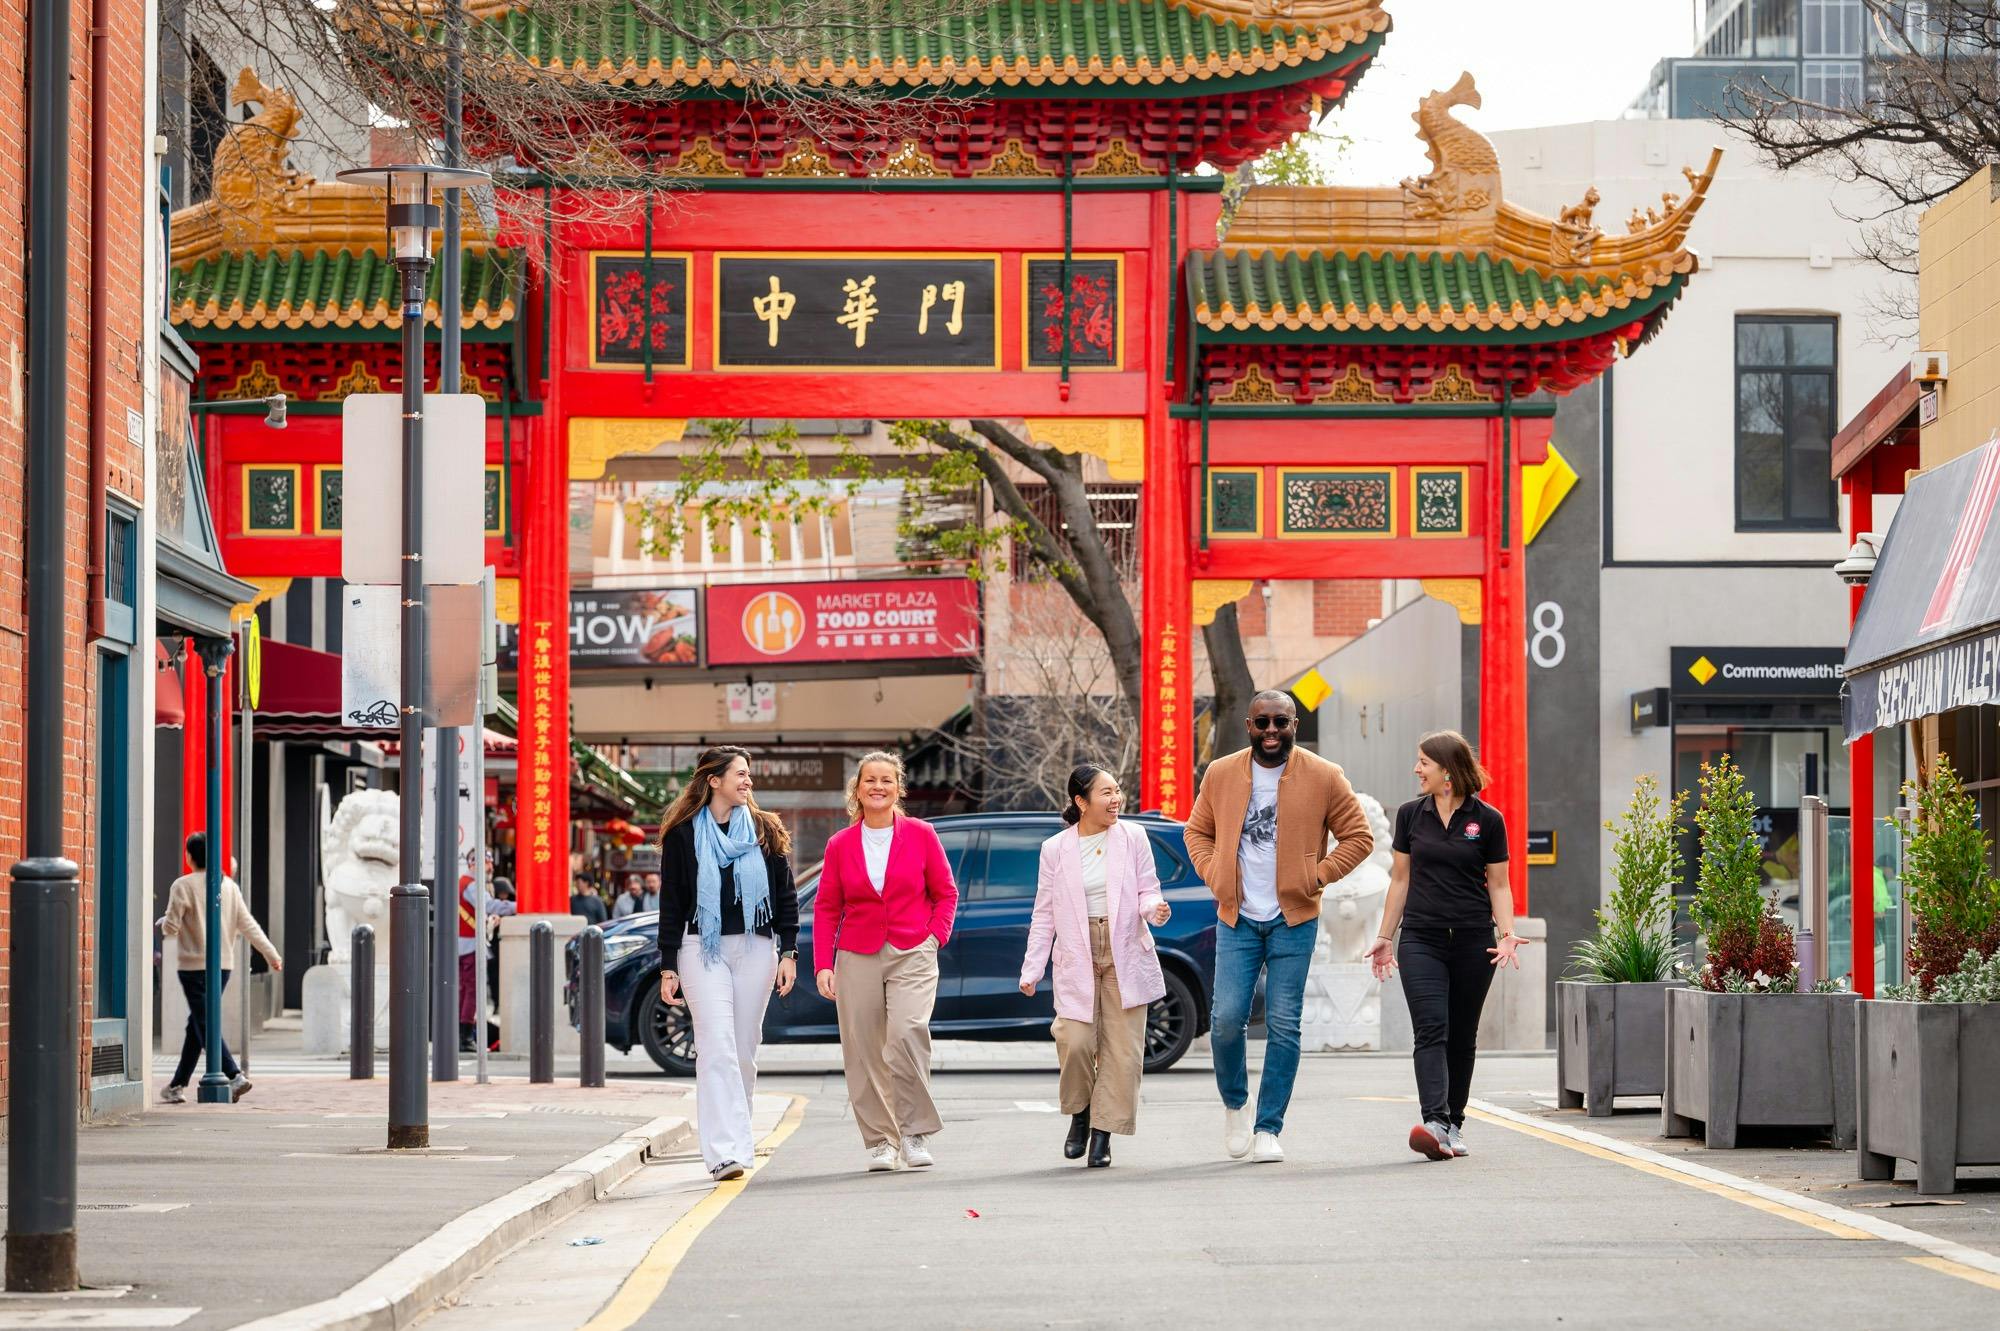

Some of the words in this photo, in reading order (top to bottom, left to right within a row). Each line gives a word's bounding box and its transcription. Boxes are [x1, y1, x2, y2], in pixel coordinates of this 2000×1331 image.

[752, 275, 966, 349] 中華門
[816, 592, 882, 610] MARKET
[885, 591, 938, 608] PLAZA
[816, 610, 871, 629] FOOD
[873, 608, 937, 627] COURT
[1524, 600, 1566, 669] 8
[1875, 651, 1945, 729] SZECHUAN
[1946, 634, 2000, 710] VALLEY
